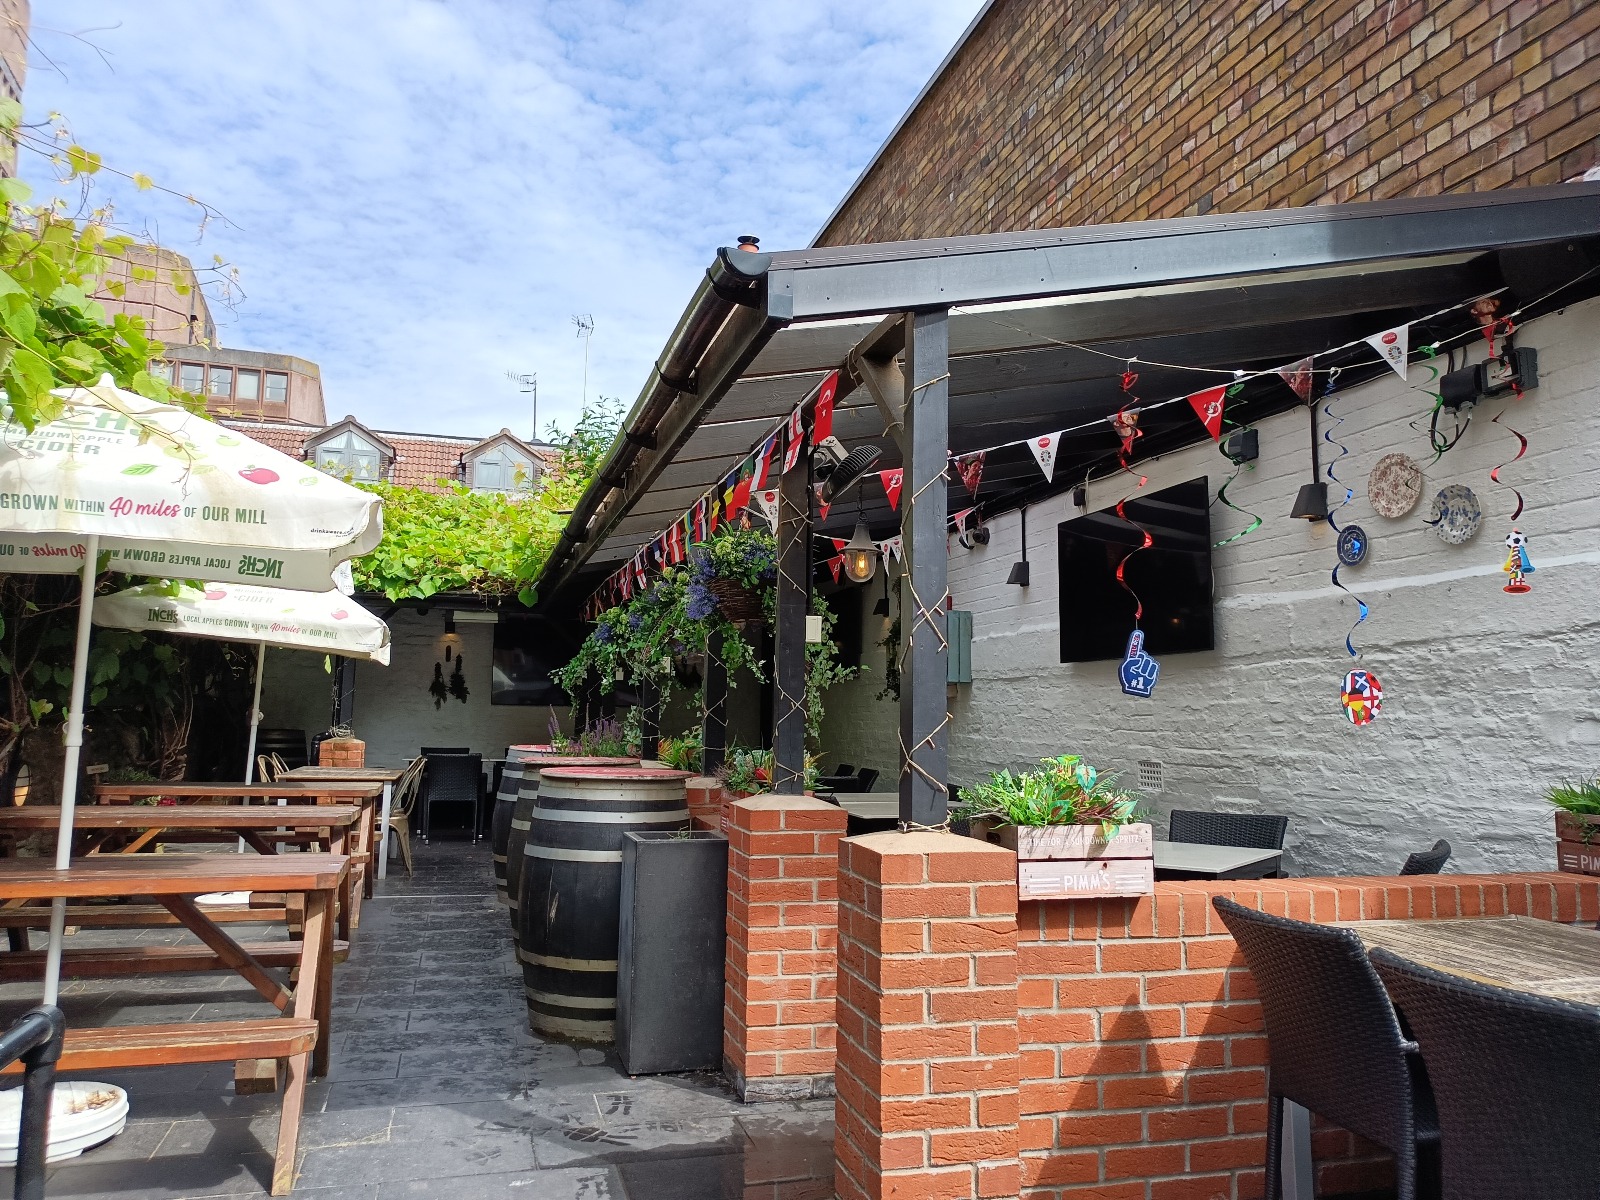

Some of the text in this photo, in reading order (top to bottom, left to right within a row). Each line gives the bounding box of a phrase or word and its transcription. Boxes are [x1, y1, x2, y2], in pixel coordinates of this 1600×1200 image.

[17, 438, 101, 455] CIDER
[77, 434, 123, 445] APPLE
[0, 493, 268, 525] GROWN WITHIN 40 miles OF OUR MILL
[183, 615, 201, 624] LOCAL
[202, 617, 223, 626] APPLES
[224, 618, 250, 629] GROWN
[269, 622, 281, 633] 40
[280, 624, 301, 634] miles
[309, 628, 322, 637] OUR
[323, 630, 338, 639] MILL
[1130, 676, 1145, 690] #1
[1063, 870, 1111, 892] PIMM'S
